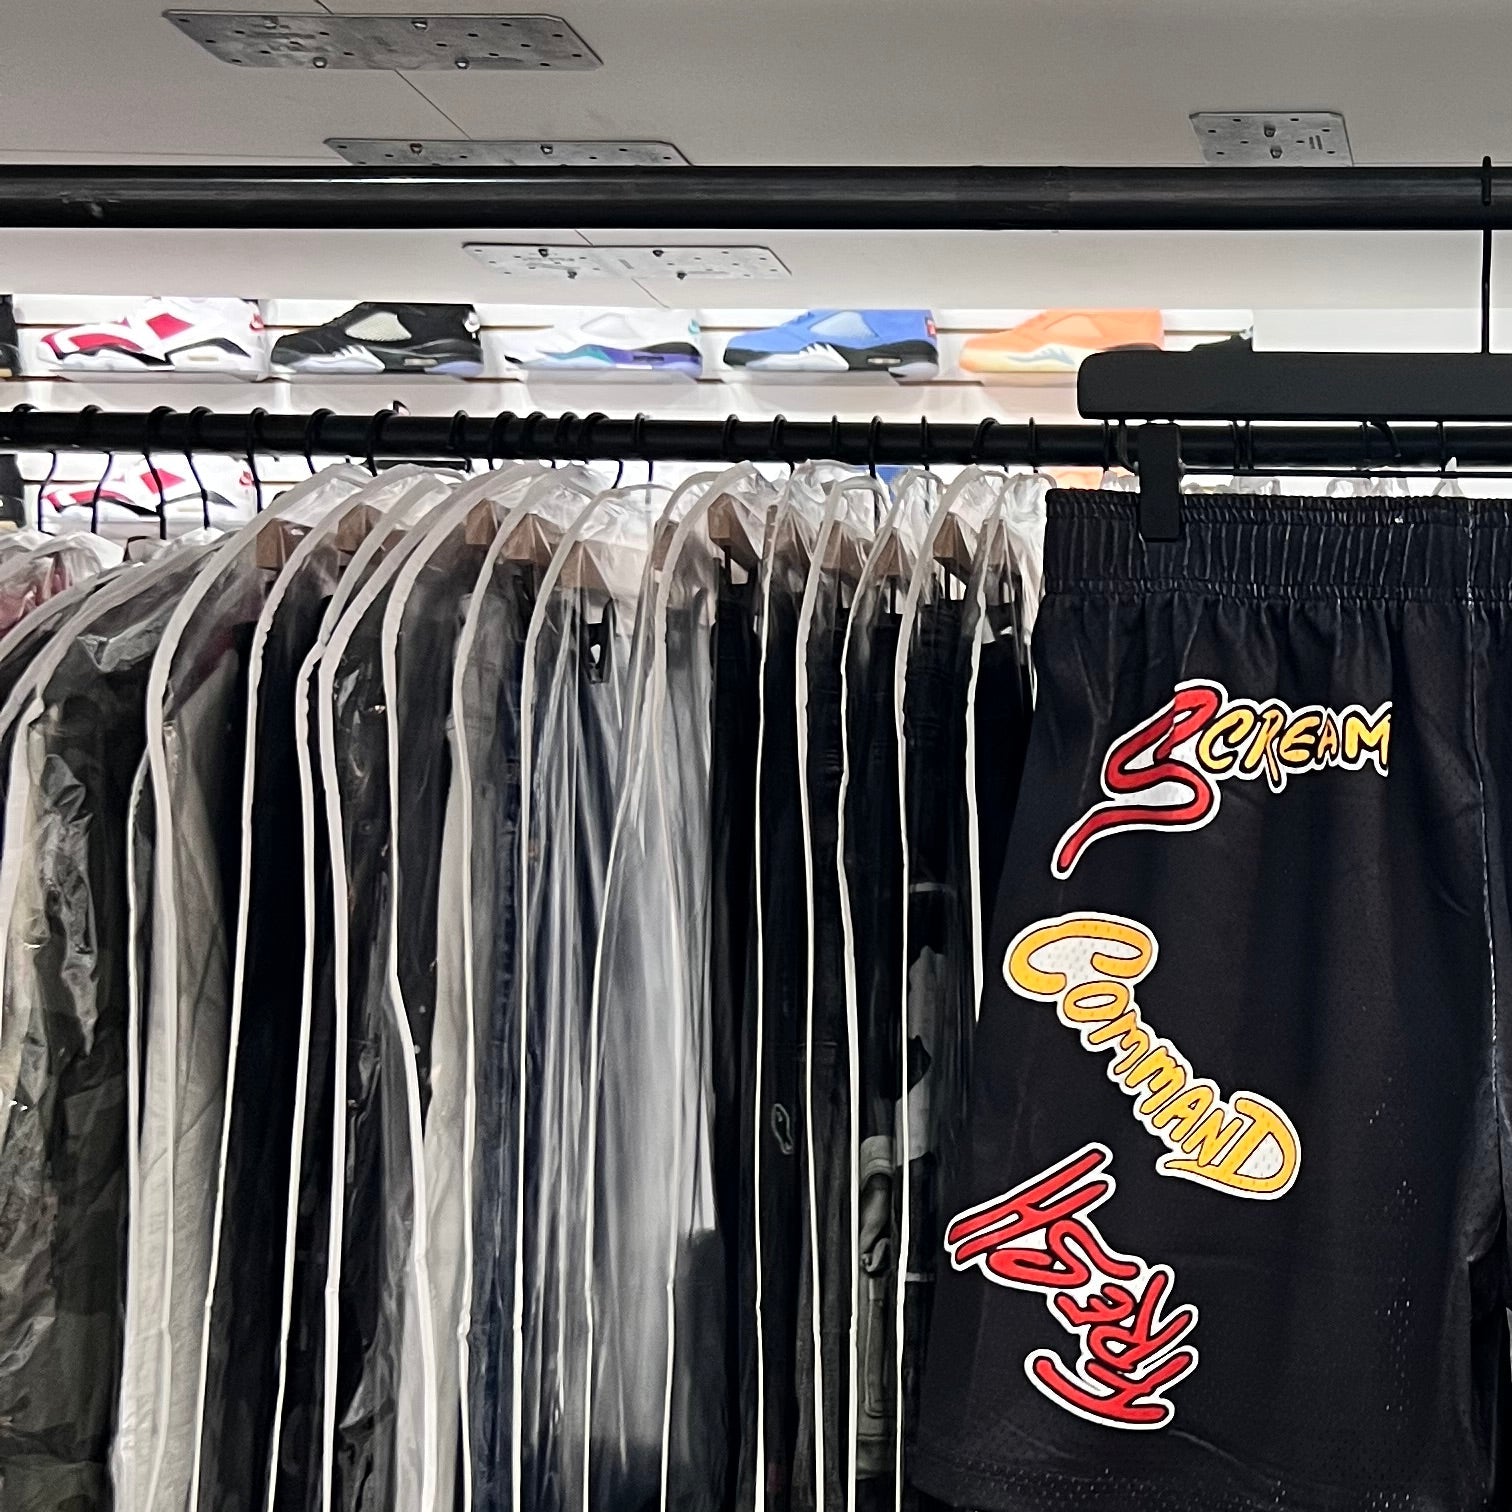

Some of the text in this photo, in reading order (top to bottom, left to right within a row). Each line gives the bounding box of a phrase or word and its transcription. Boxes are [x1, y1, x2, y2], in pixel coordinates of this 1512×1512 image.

[1054, 682, 1392, 876] SCREAM
[1003, 914, 1300, 1197] COMMAND
[946, 1145, 1196, 1427] FRESH
